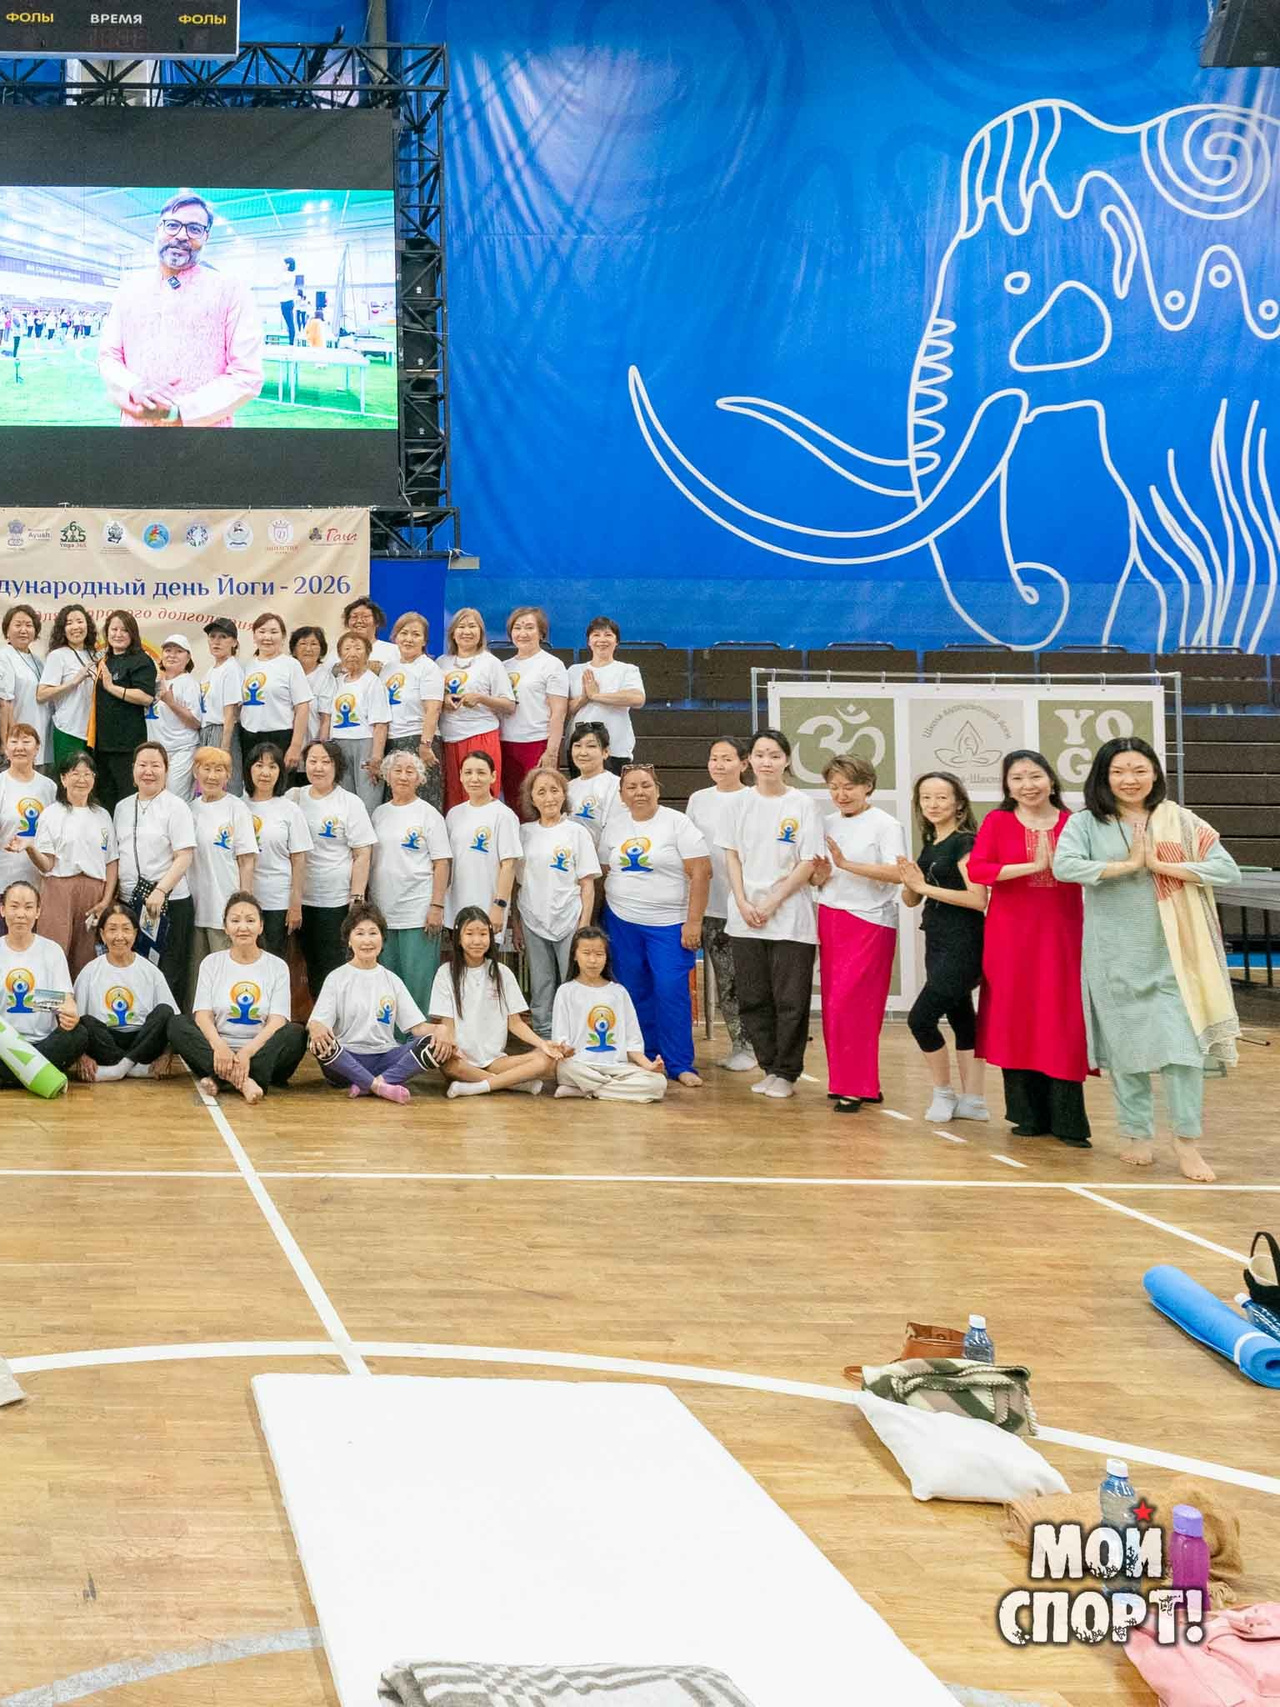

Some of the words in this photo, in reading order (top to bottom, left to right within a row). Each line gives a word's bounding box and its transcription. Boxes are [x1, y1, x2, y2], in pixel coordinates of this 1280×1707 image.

[6, 12, 54, 24] ФОЛЫ
[90, 13, 142, 24] ВРЕМЯ
[178, 14, 227, 25] ФОЛЫ
[152, 580, 210, 600] день
[217, 574, 275, 596] Йоги
[293, 575, 351, 595] 2026
[1054, 708, 1133, 745] YO
[1057, 747, 1093, 783] G
